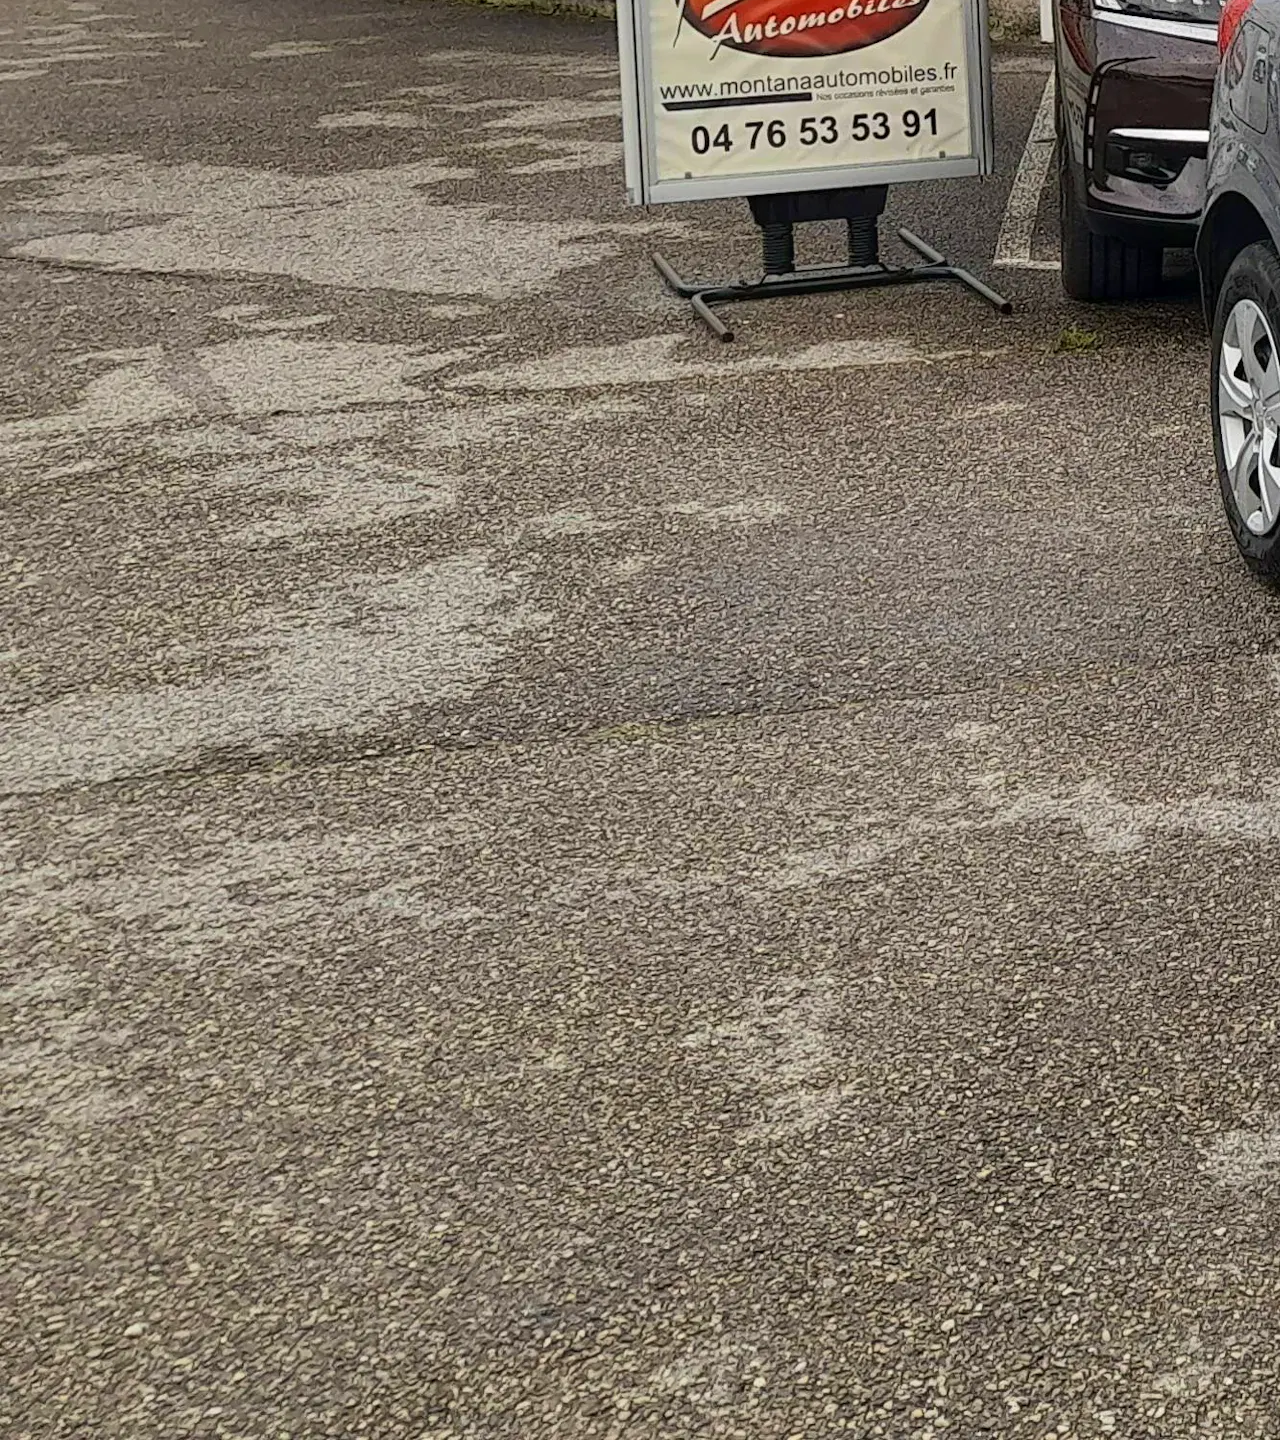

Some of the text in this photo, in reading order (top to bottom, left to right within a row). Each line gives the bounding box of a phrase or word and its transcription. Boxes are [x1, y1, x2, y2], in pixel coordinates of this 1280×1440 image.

[660, 62, 957, 99] www.montanaautomobiles.fr
[691, 108, 938, 154] 04 76 53 53 91
